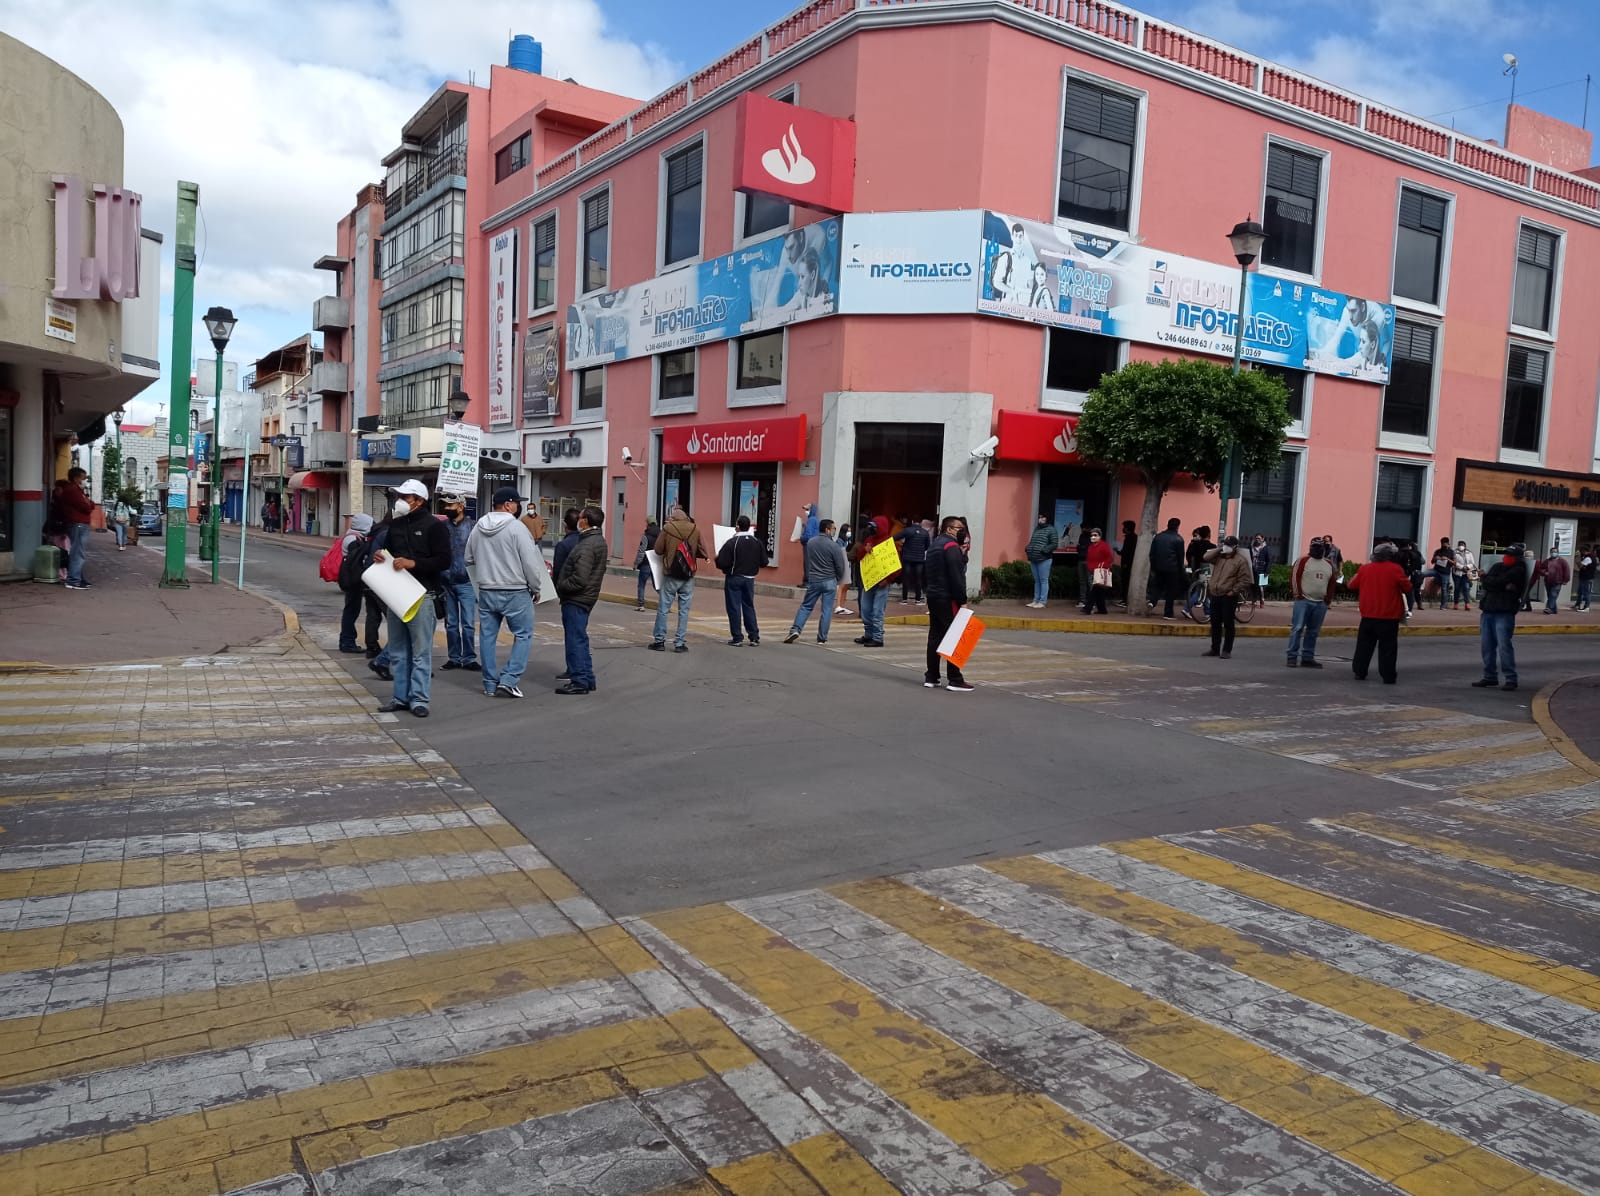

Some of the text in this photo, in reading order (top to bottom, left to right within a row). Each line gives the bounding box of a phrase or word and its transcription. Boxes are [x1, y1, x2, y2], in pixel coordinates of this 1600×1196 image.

[1057, 264, 1113, 292] WORLD
[1058, 282, 1109, 304] ENGLISH
[1164, 332, 1176, 342] 246
[1177, 334, 1190, 344] 464
[1199, 339, 1208, 348] 63
[1221, 343, 1233, 353] 246
[701, 430, 765, 454] Santander
[442, 458, 476, 473] 50%
